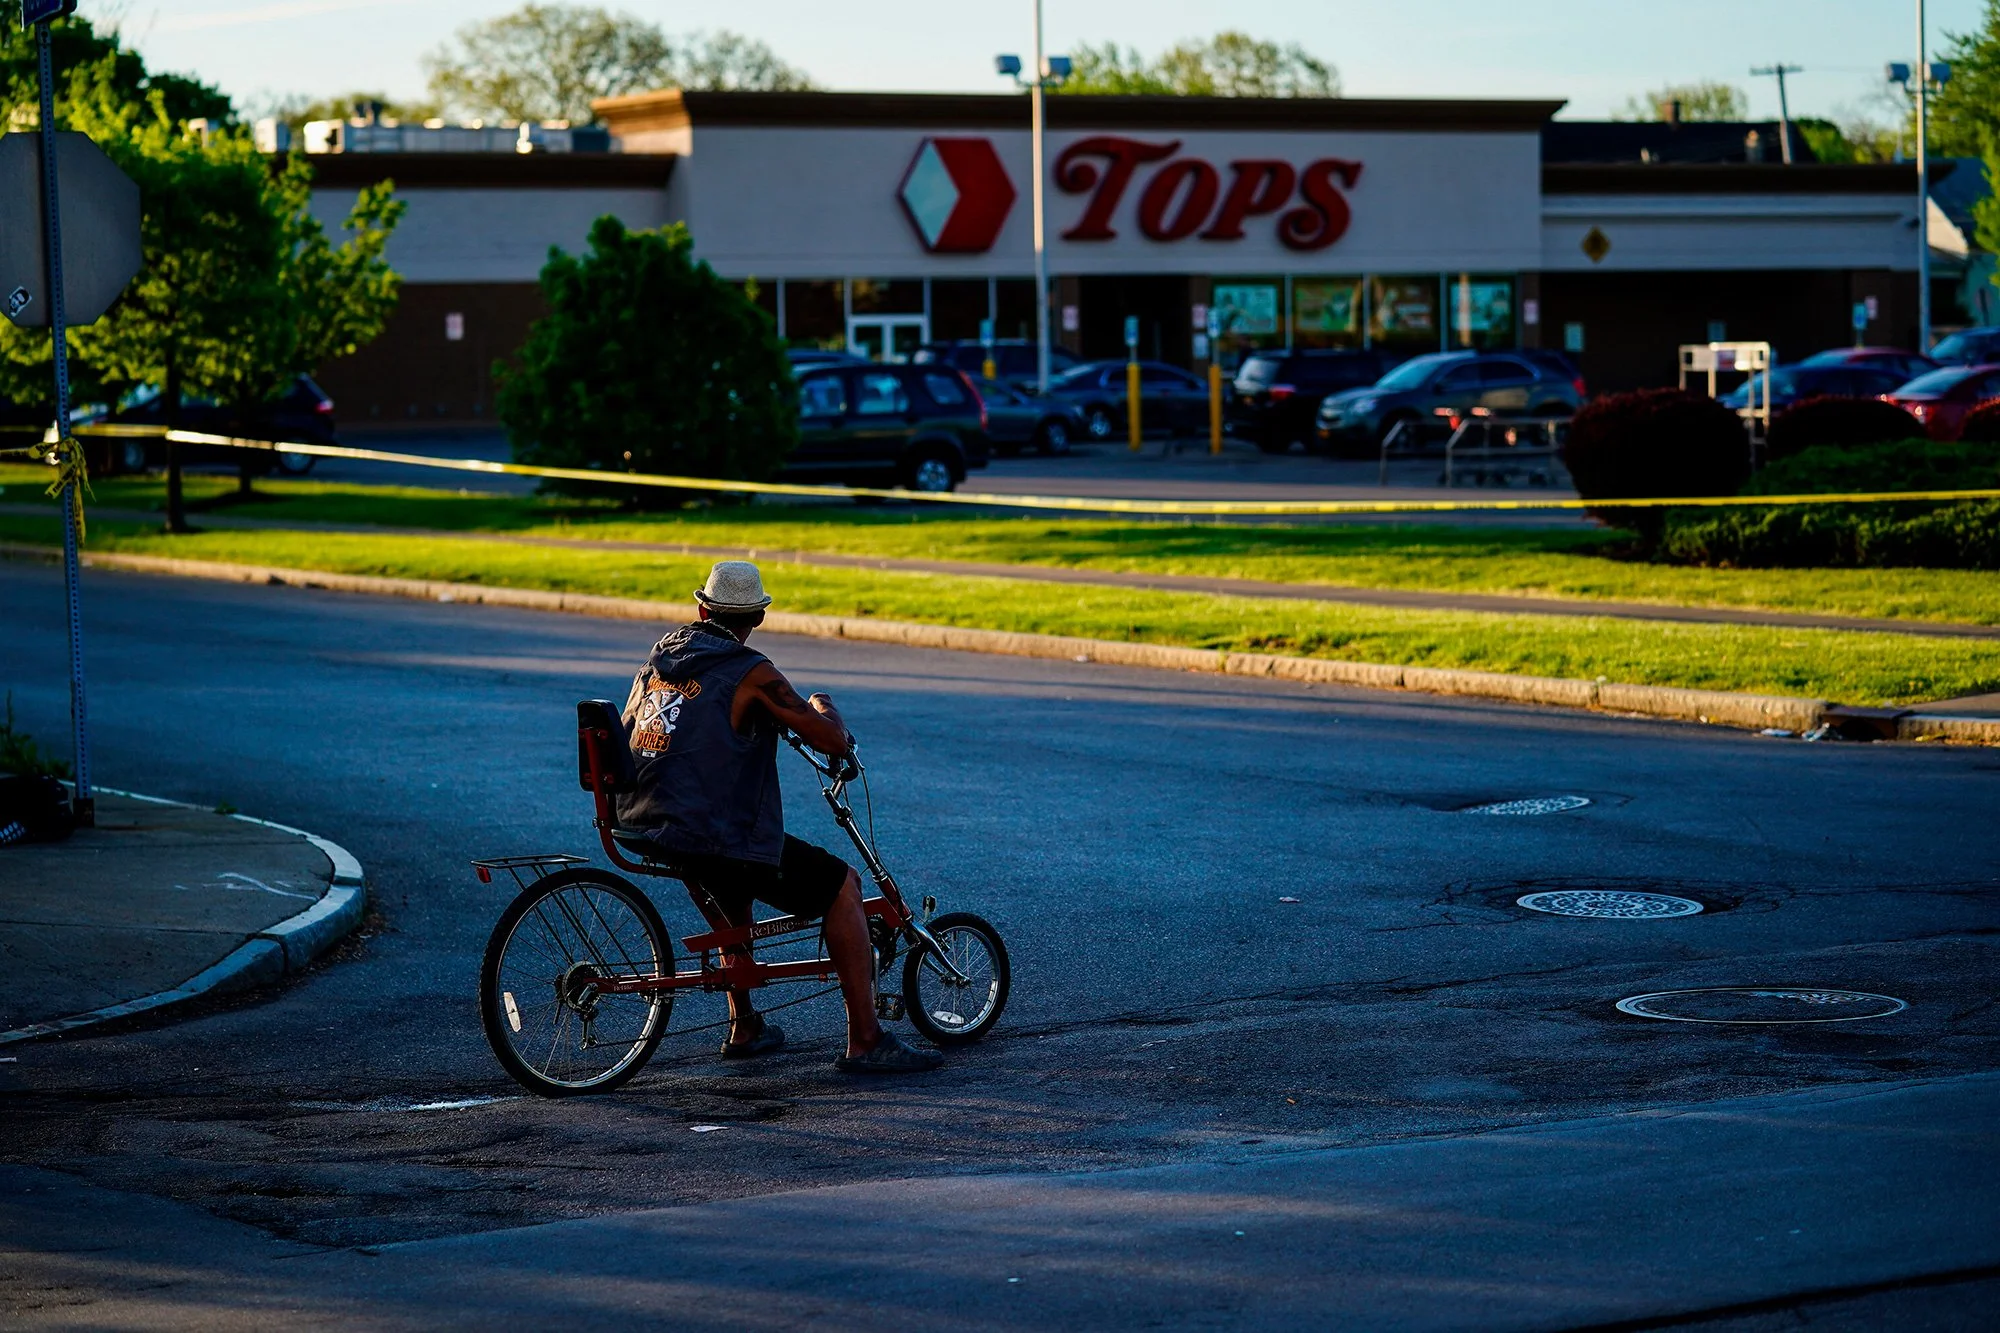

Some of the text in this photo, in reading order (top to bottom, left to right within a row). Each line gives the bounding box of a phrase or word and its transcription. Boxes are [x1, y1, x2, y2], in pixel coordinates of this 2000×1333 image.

[1053, 135, 1364, 250] TOPS
[636, 731, 671, 752] DUKES
[750, 921, 795, 938] ReBike
